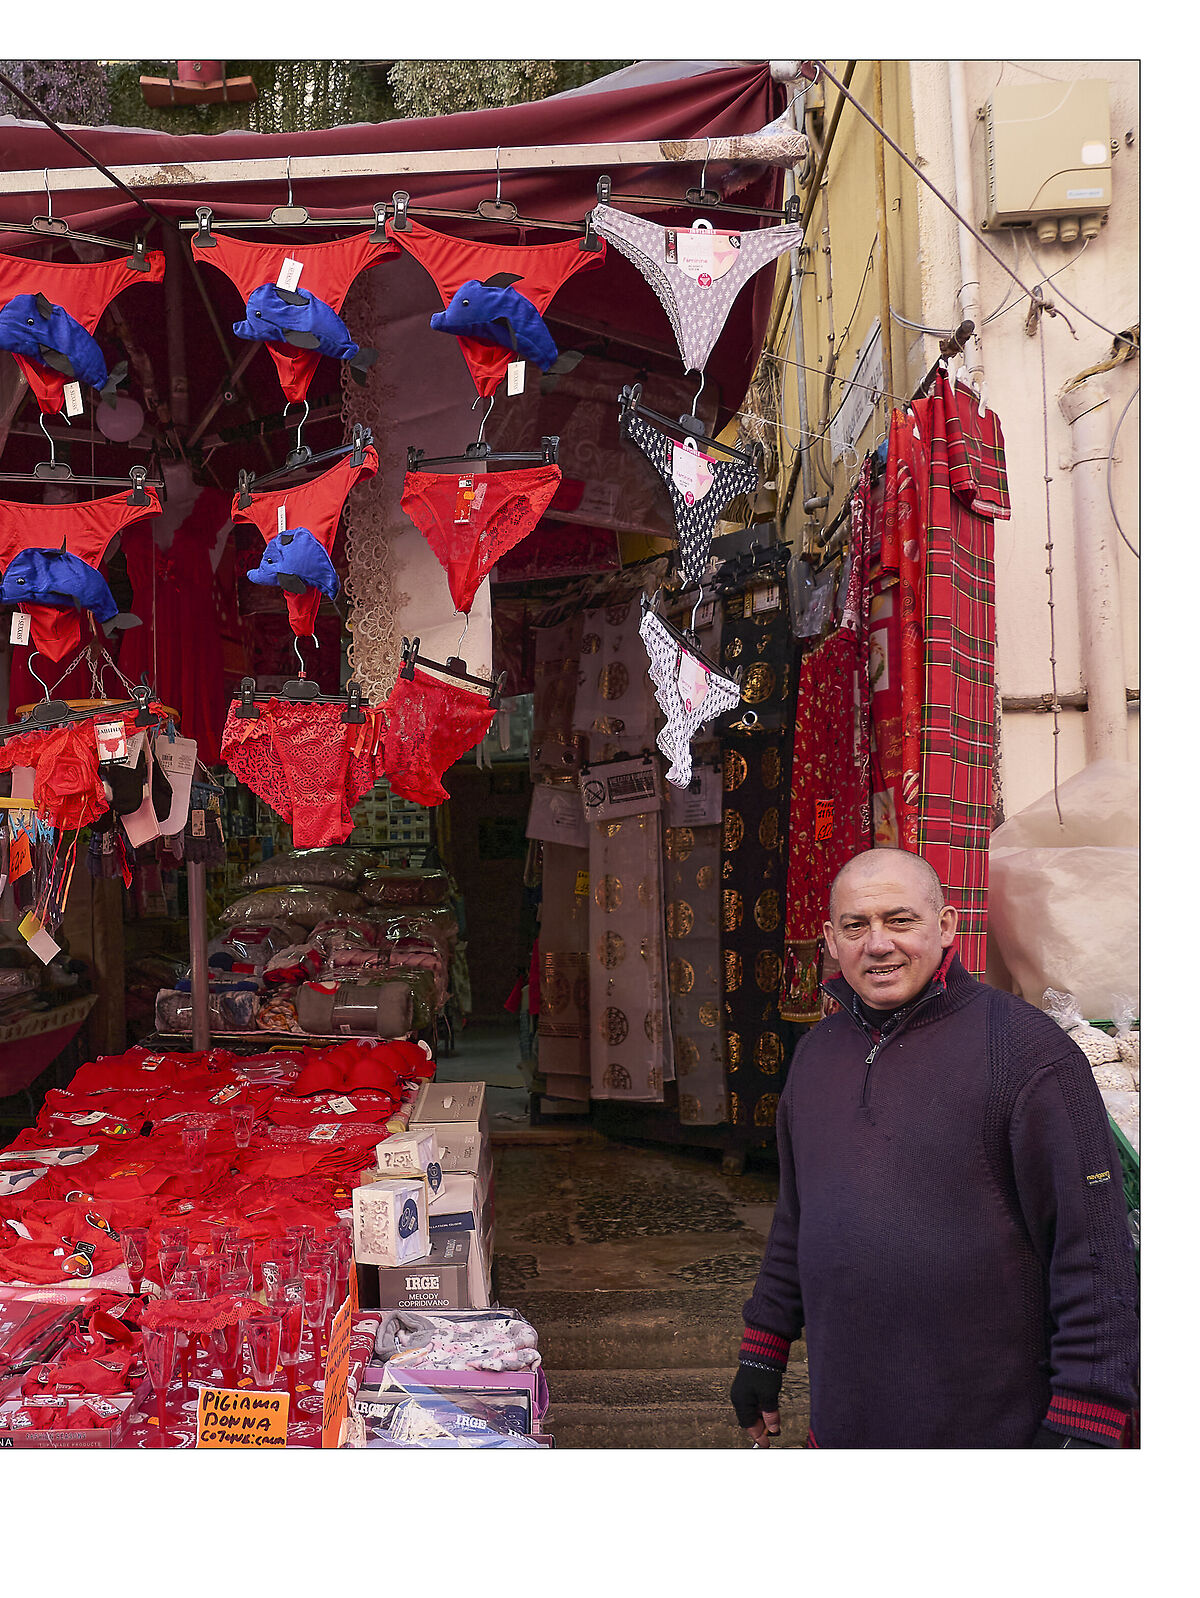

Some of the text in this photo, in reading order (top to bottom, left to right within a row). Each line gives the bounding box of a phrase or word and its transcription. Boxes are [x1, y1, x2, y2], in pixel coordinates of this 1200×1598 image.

[405, 1276, 440, 1291] IRGE
[398, 1299, 450, 1308] COPRIDIVANO
[408, 1293, 439, 1301] MELODY
[204, 1412, 272, 1431] DONNA
[455, 1414, 488, 1430] IRGE
